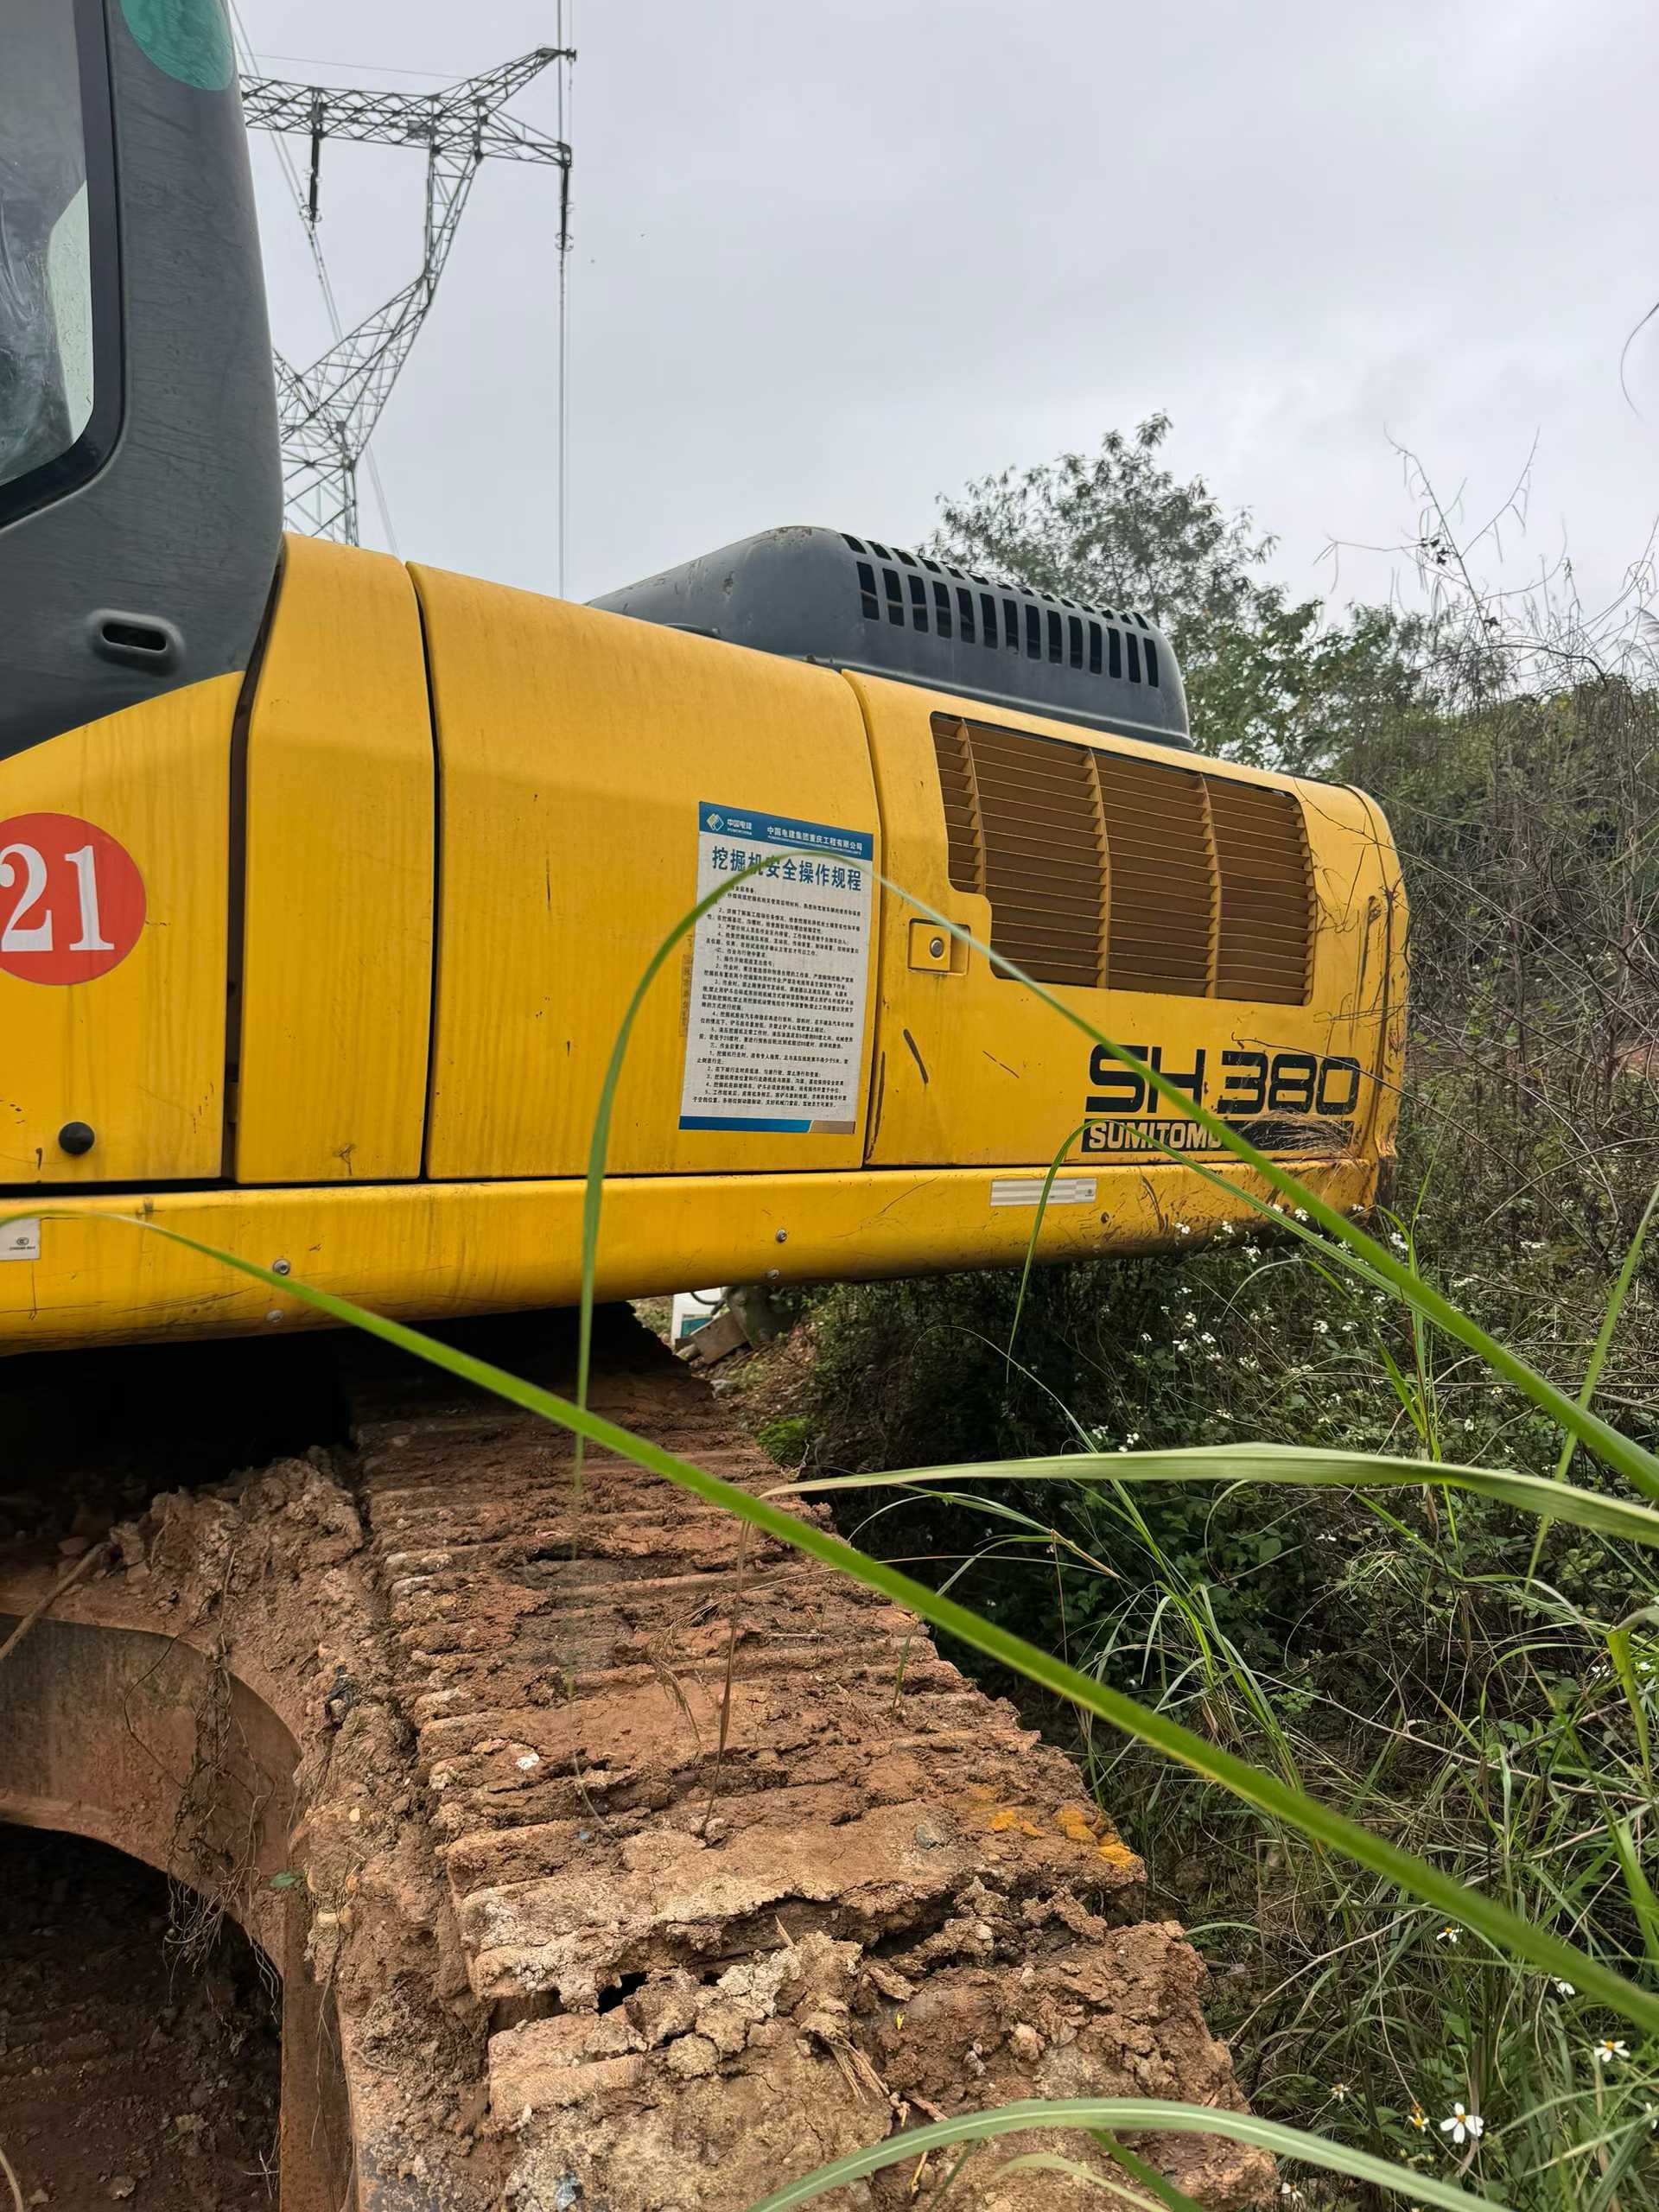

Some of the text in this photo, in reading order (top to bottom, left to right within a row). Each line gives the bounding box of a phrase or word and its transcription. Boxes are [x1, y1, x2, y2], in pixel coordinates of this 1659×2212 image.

[0, 842, 116, 953] 21
[710, 844, 862, 892] 挖掘机安全操作规程
